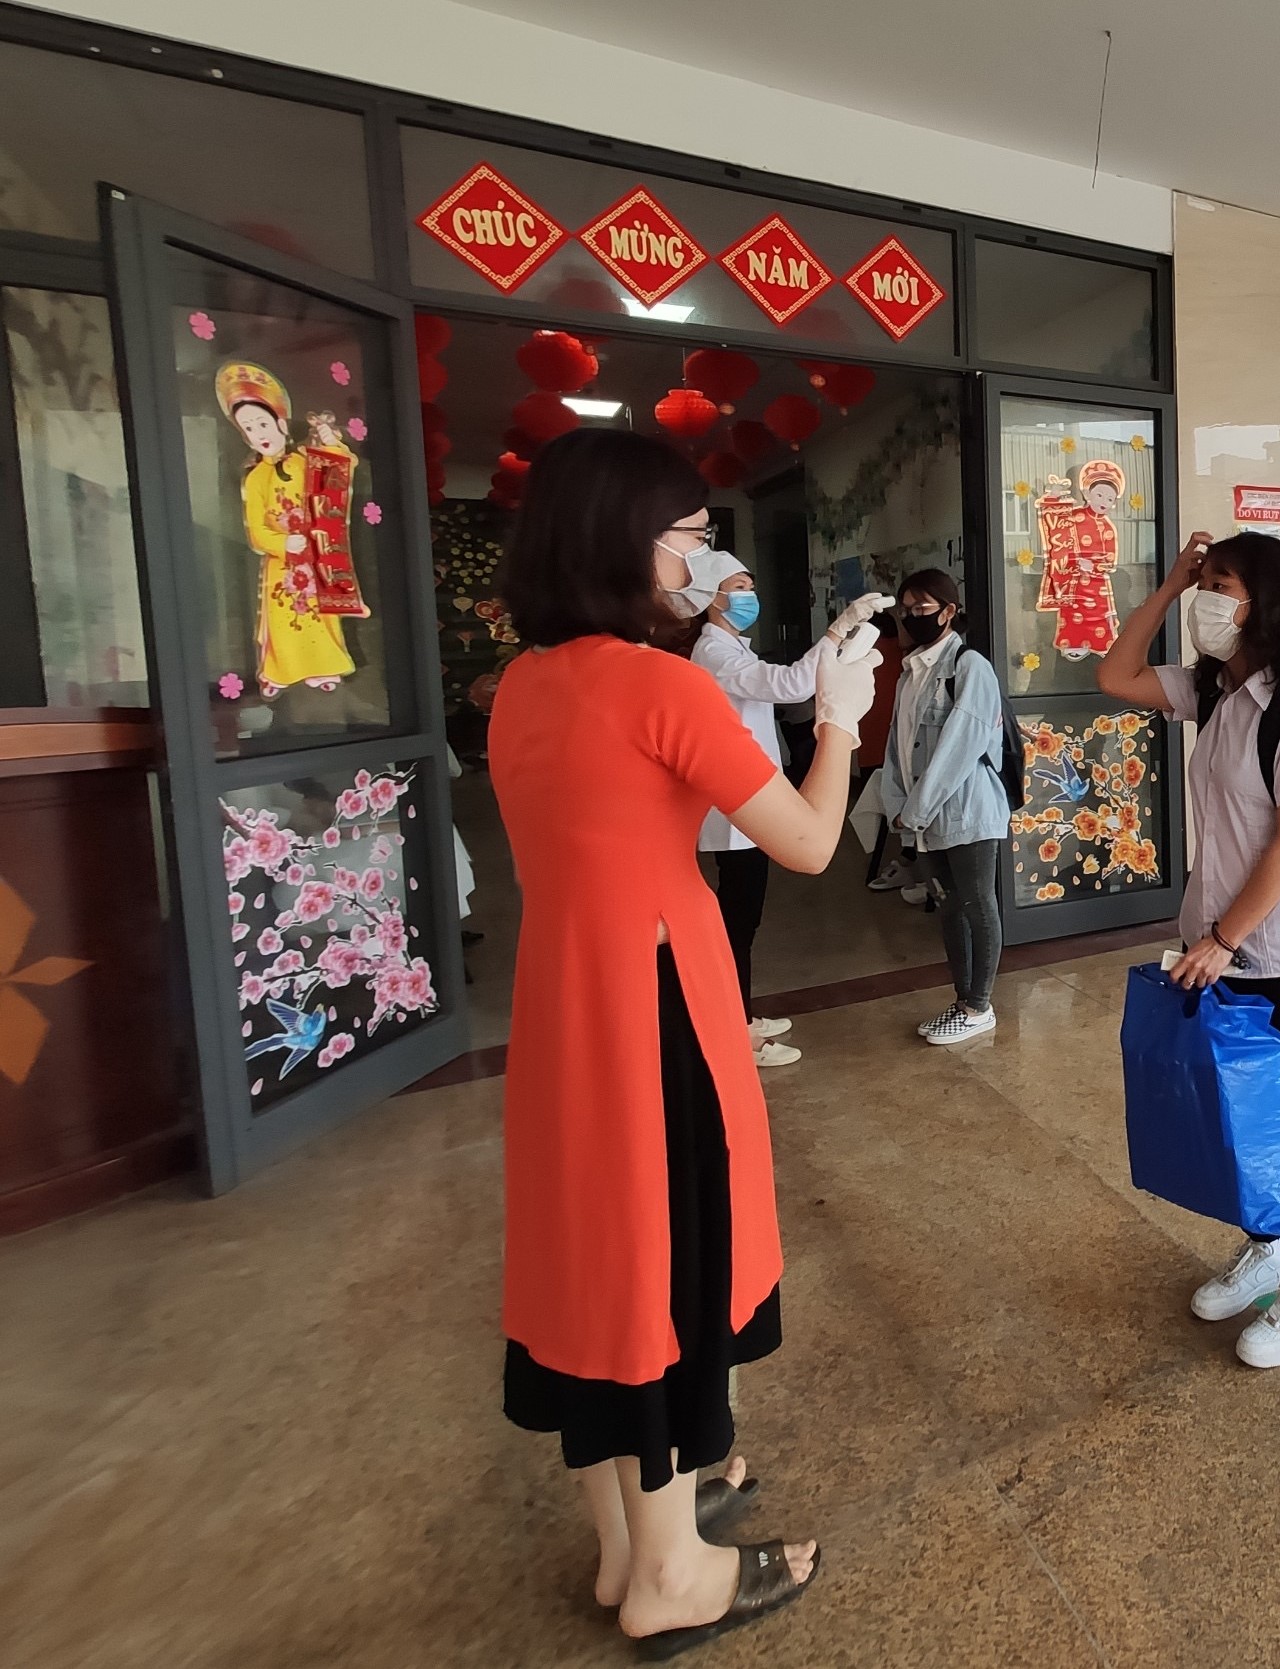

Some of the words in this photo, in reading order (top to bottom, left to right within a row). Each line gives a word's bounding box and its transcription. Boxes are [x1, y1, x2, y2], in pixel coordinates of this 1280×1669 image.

[452, 200, 537, 248] CHÚC
[609, 220, 685, 269] MỪNG
[747, 245, 810, 291] NĂM
[872, 258, 919, 306] MỚI
[758, 1551, 769, 1568] VIP
